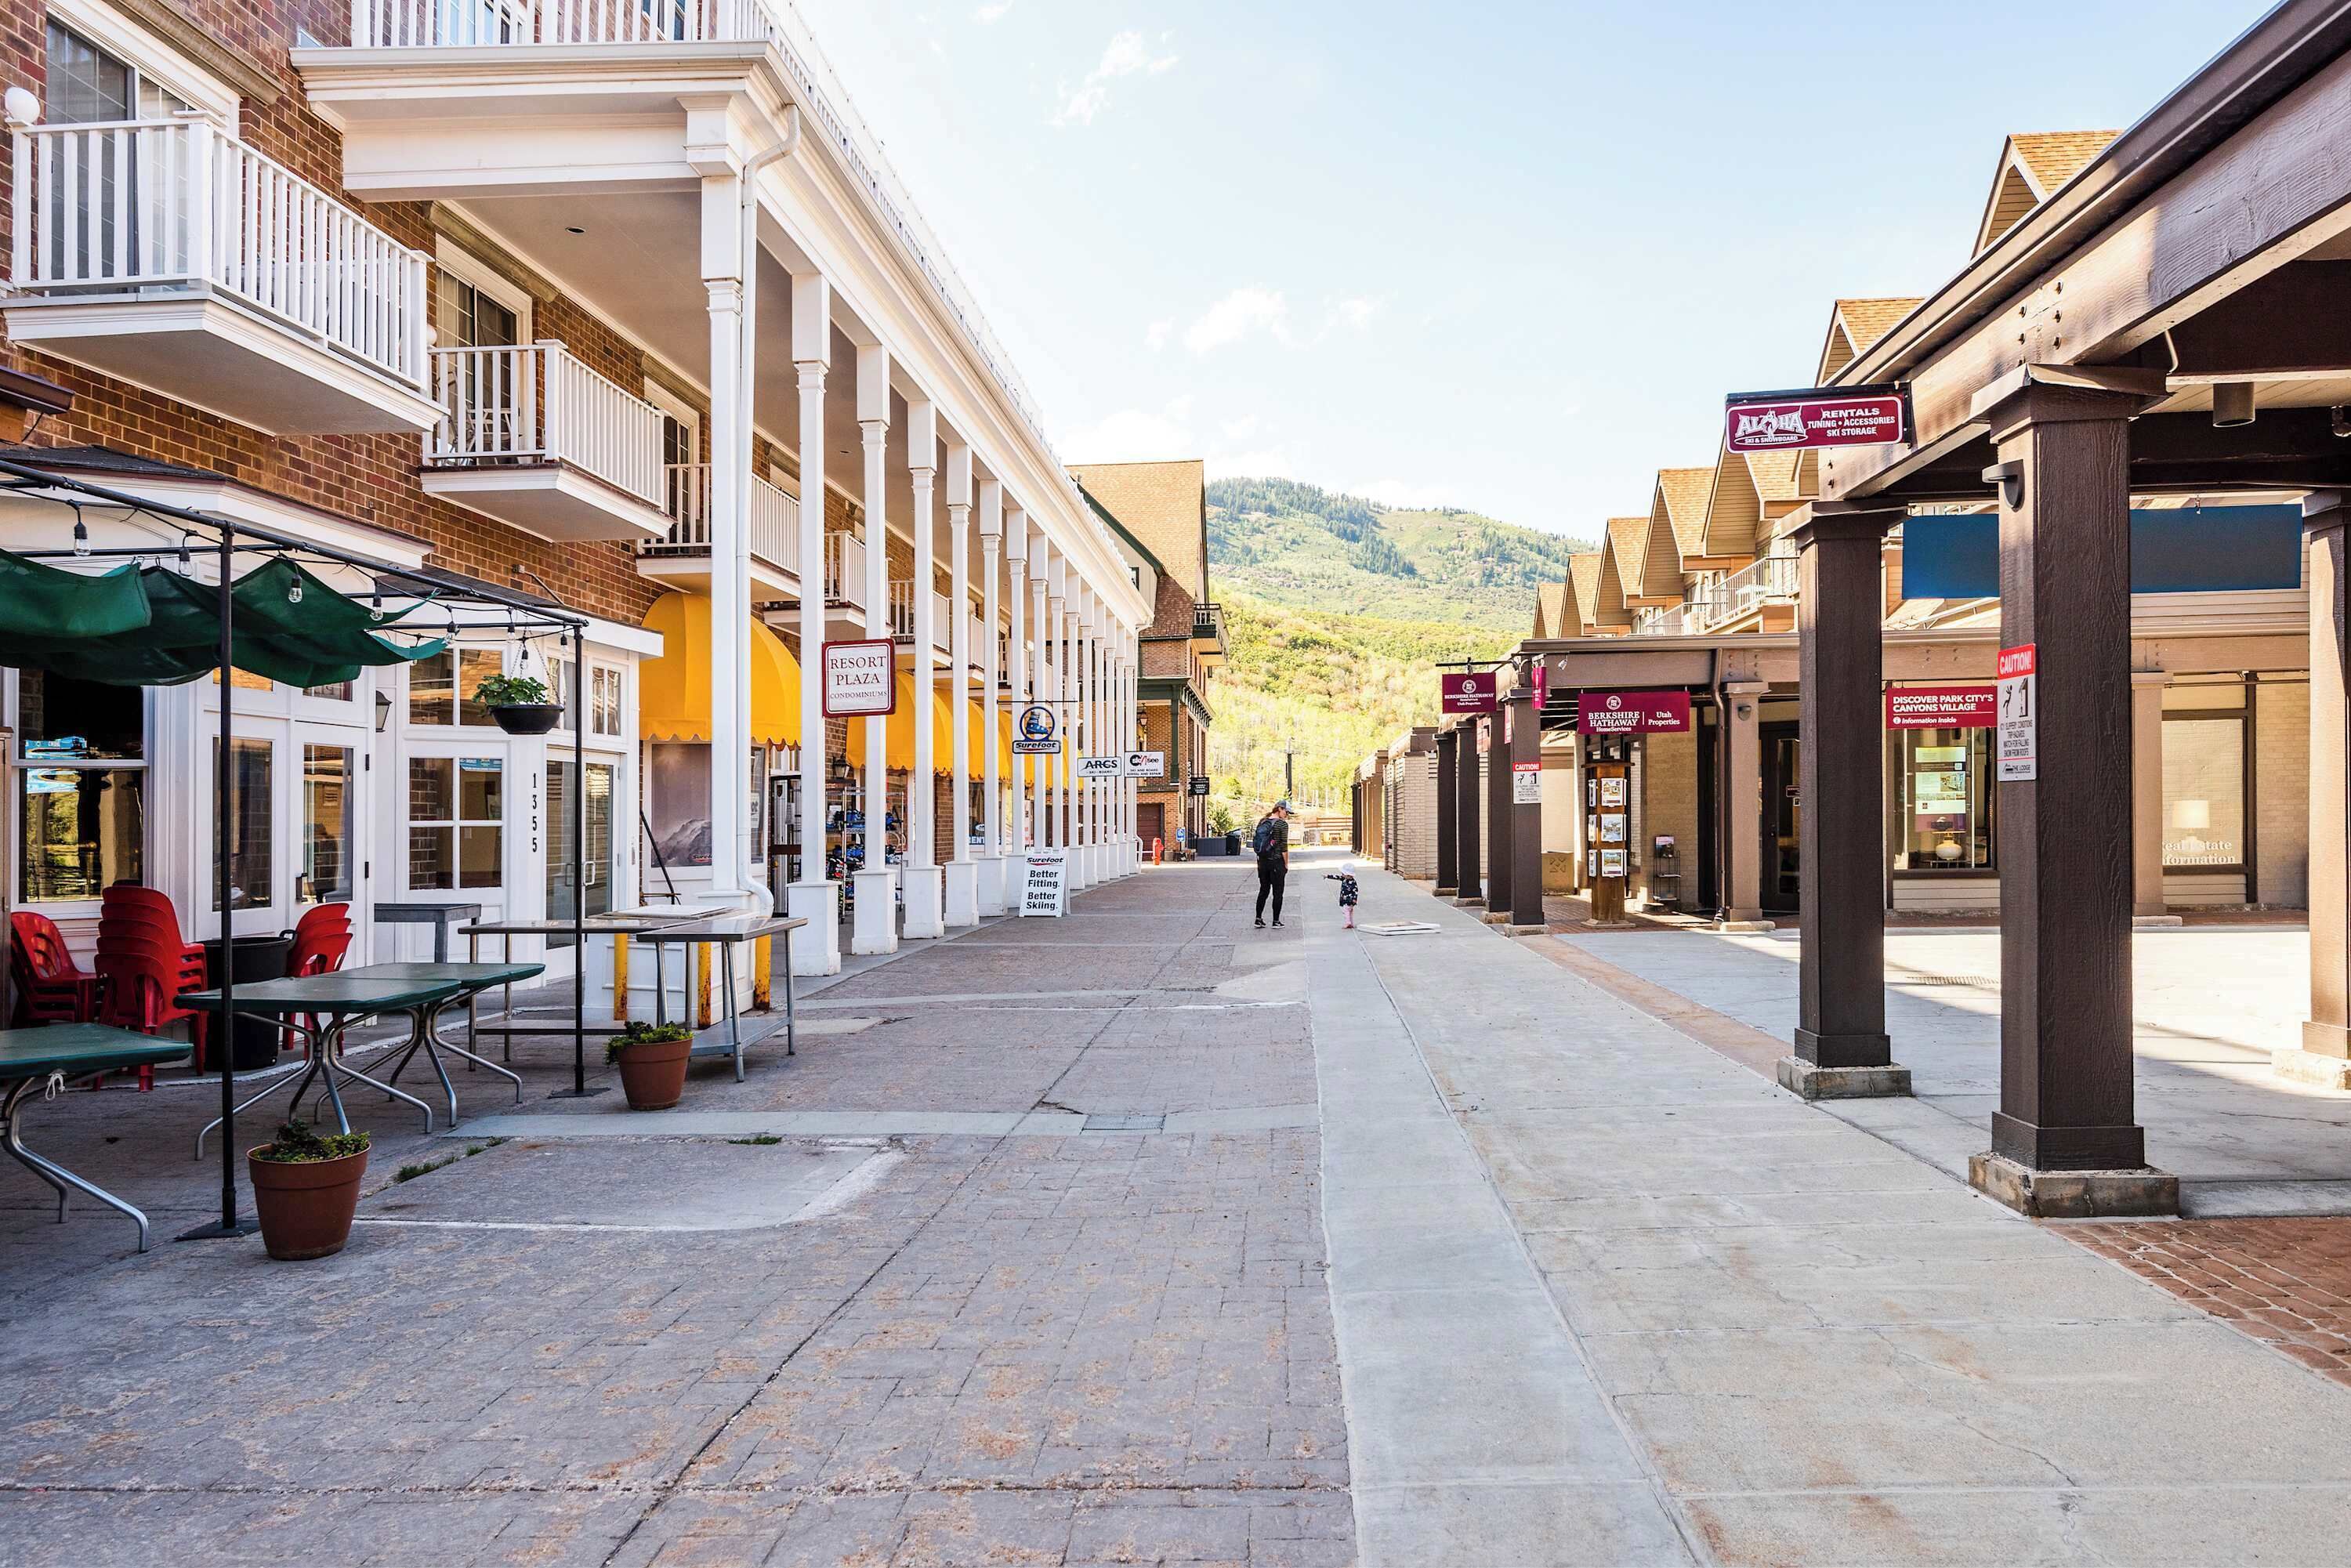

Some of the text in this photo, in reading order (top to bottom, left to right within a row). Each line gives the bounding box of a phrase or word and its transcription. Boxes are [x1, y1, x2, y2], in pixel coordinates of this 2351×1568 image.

[1821, 407, 1880, 418] RENTALS
[1735, 409, 1806, 437] ALOHA
[1807, 416, 1895, 429] TUNING ACCESSORIES
[1827, 427, 1878, 437] SKI STORAGE
[830, 656, 886, 669] RESORT
[1999, 650, 2032, 675] CAUTION!
[836, 673, 880, 686] PLAZA
[830, 690, 887, 699] CONDOMINIUMS
[1085, 760, 1118, 769] ARCS
[1027, 879, 1060, 889] Fitting.
[1026, 901, 1058, 911] Skiing.
